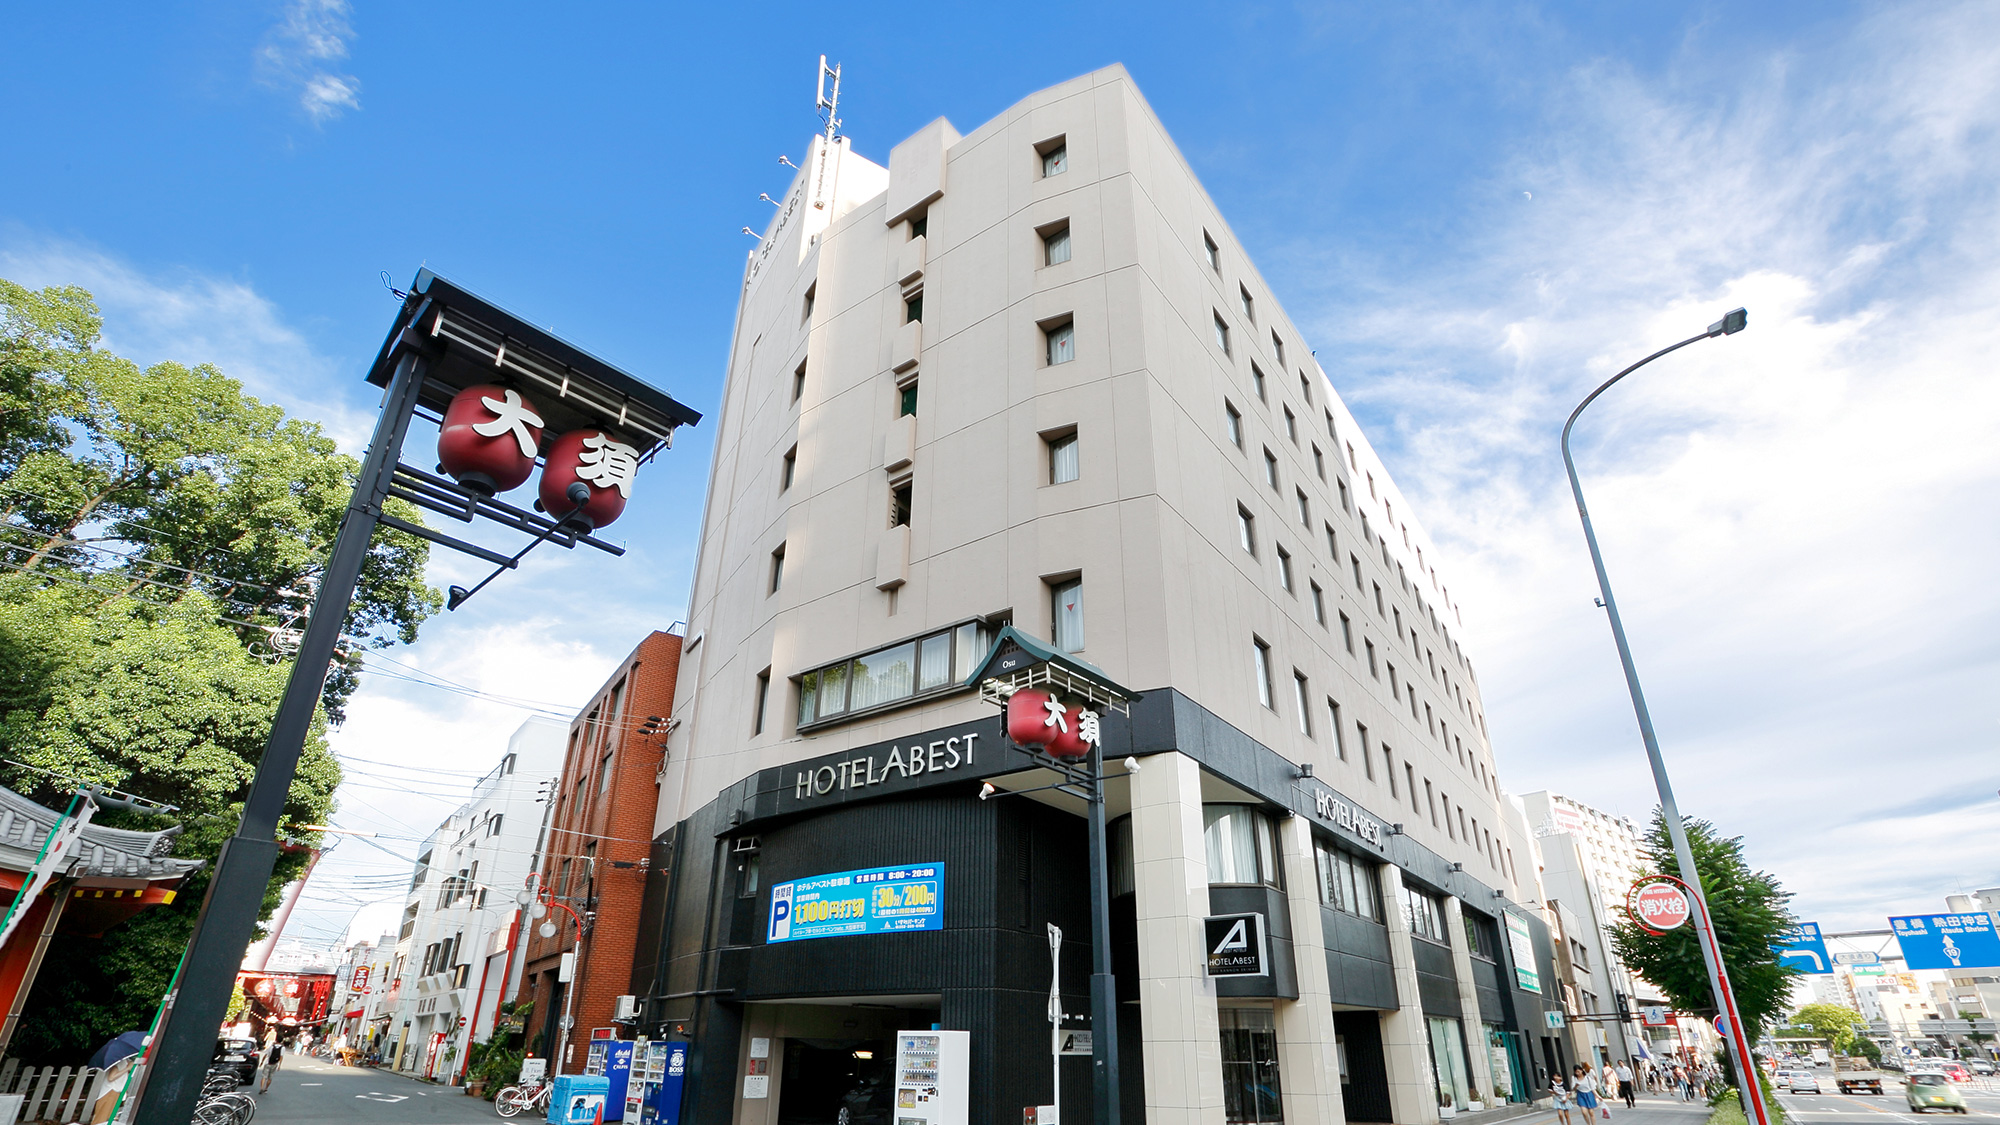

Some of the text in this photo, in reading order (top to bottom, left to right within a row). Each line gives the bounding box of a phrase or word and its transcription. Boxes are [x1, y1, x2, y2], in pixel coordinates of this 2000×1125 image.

[472, 389, 641, 500] 大須
[1002, 660, 1016, 669] Osu
[1043, 693, 1101, 748] 大須
[1641, 897, 1685, 916] 消火栓
[771, 900, 790, 938] P
[1931, 914, 1990, 928] 熱田神宮
[1896, 929, 1929, 937] Toyohashi
[1947, 948, 1958, 957] 19
